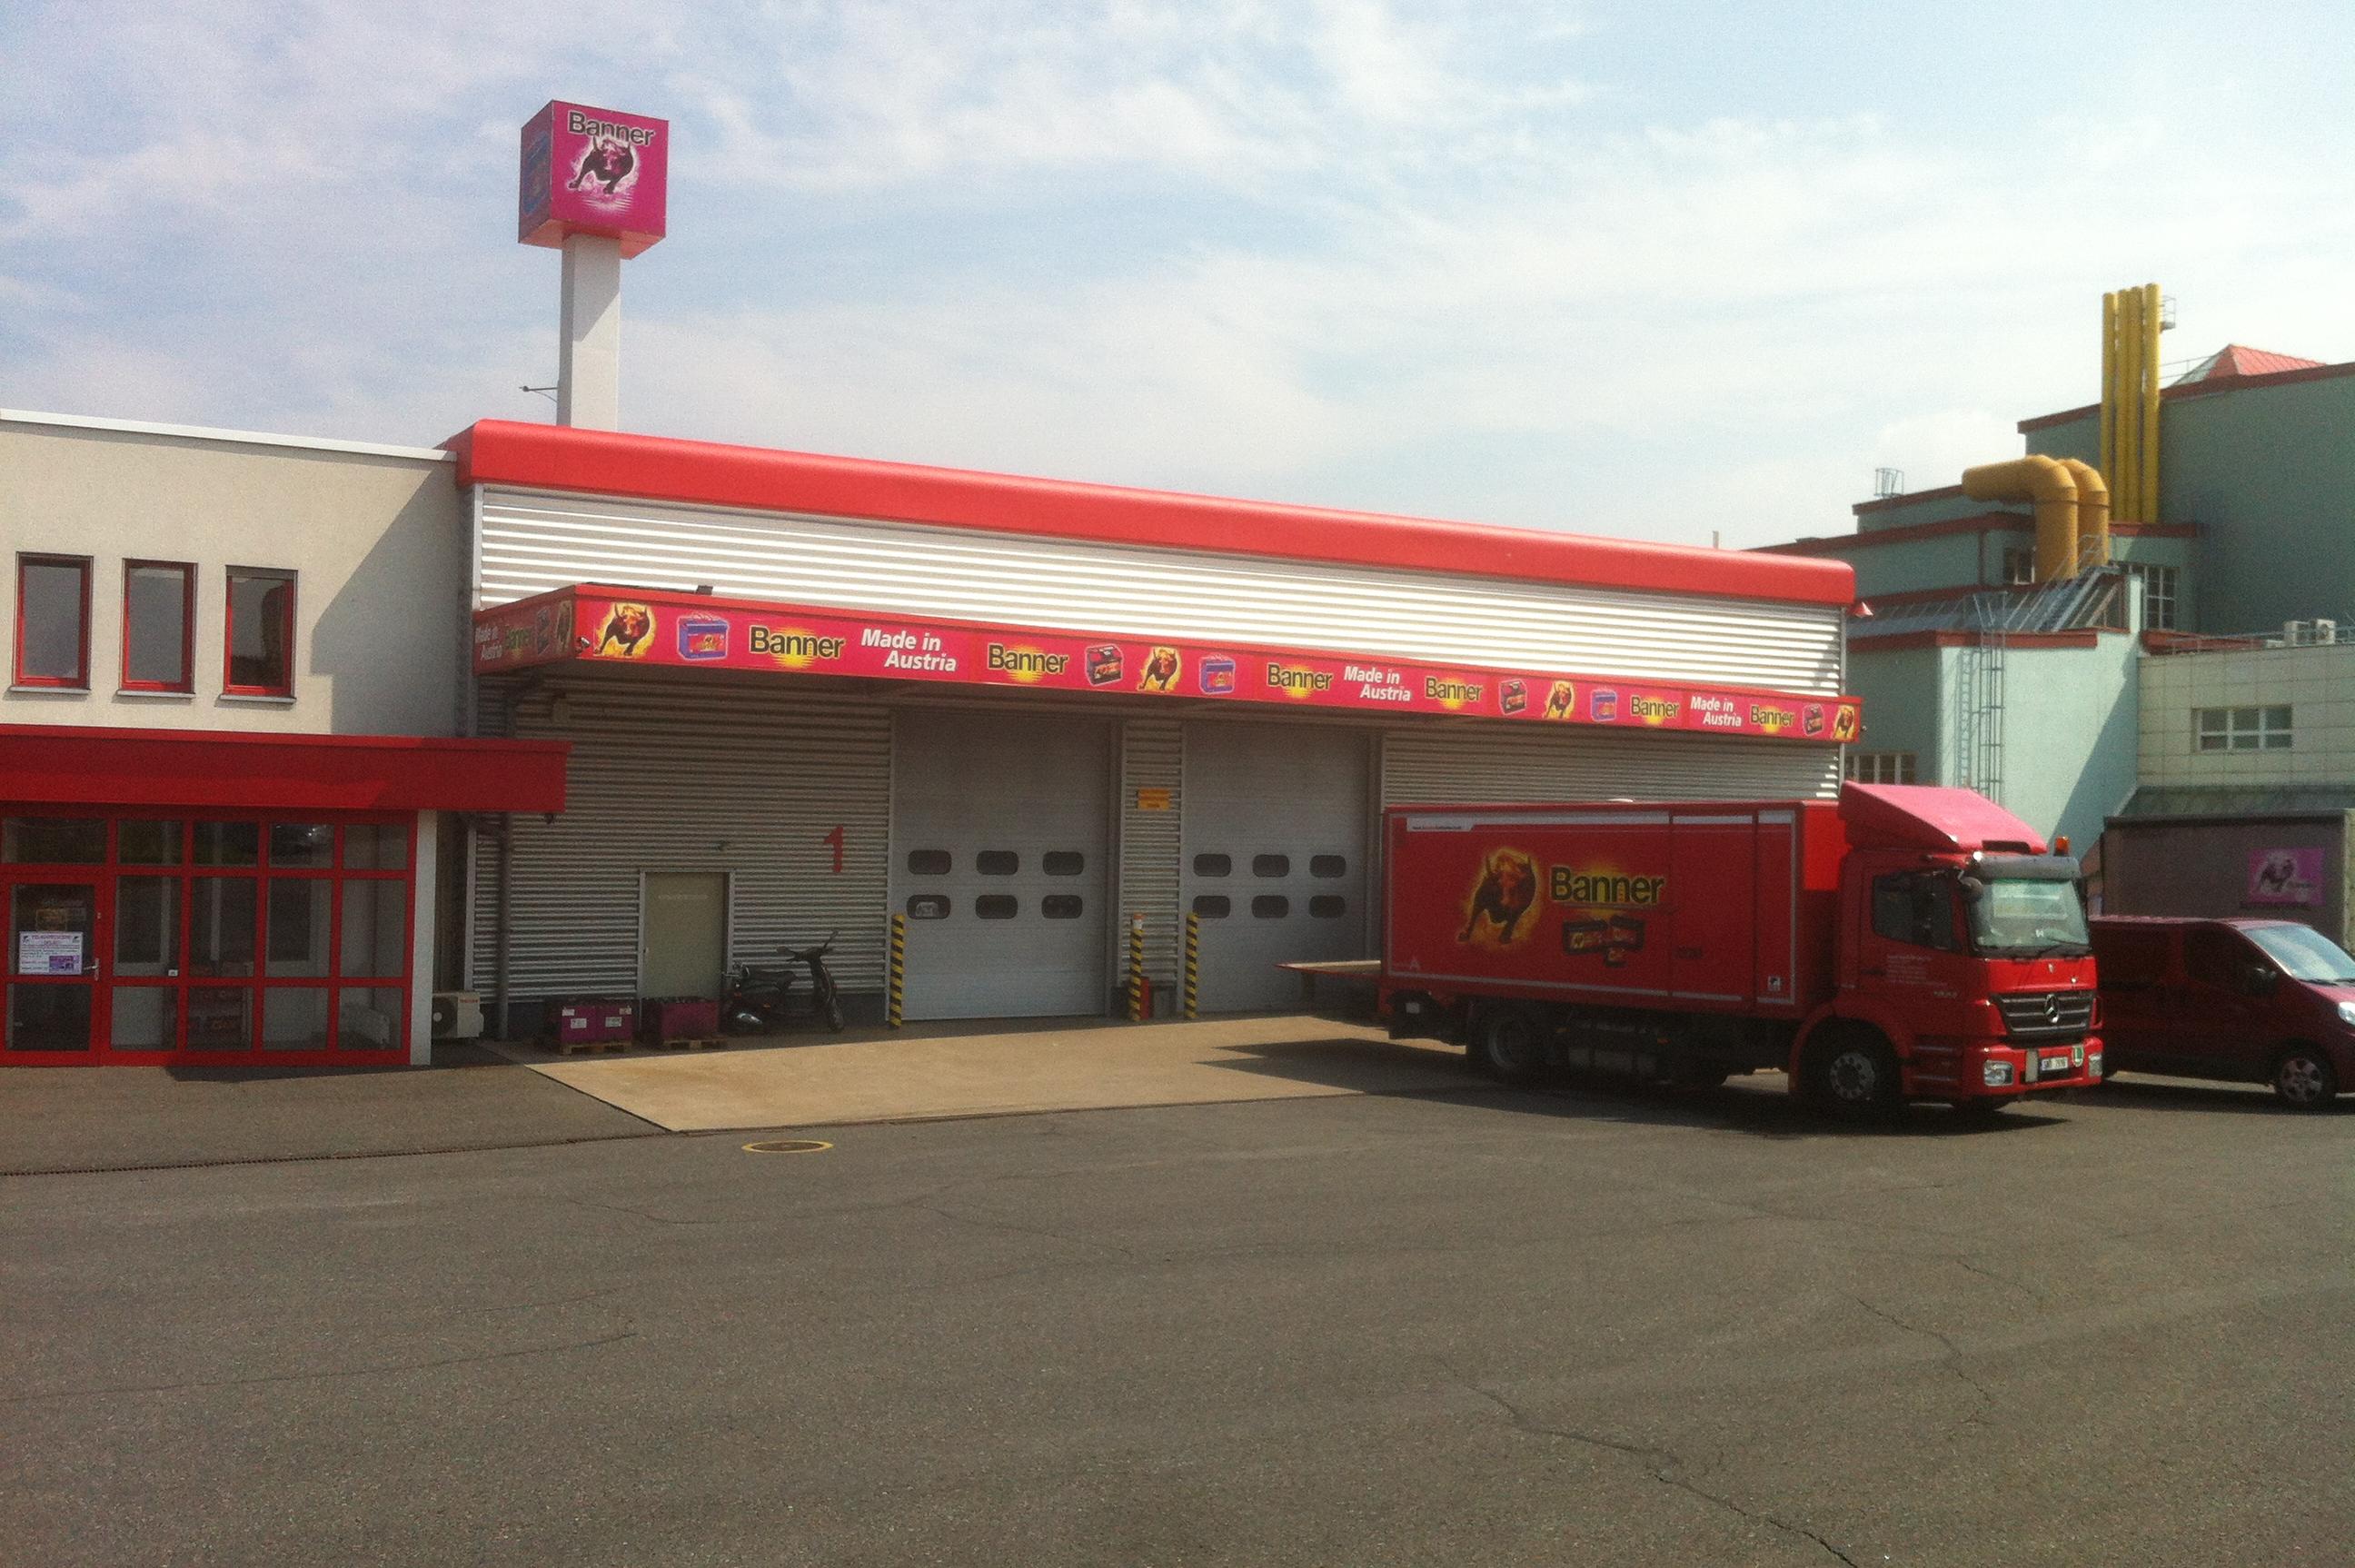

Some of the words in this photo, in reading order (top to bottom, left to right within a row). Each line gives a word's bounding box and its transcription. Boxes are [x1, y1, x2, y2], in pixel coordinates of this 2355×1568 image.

[567, 111, 655, 145] Banner
[749, 625, 845, 659] Banner
[861, 628, 917, 650] Made
[922, 631, 941, 651] in
[884, 650, 957, 672] Austria
[988, 643, 1069, 675] Banner
[1267, 662, 1334, 691] Banner
[1344, 666, 1384, 684] Made
[1386, 668, 1400, 685] in
[1359, 684, 1411, 702] Austria
[1425, 676, 1484, 702] Banner
[1631, 695, 1680, 719] Banner
[1690, 695, 1720, 712] Made
[1723, 697, 1734, 713] in
[1750, 704, 1795, 728] Banner
[1703, 711, 1743, 728] Austria
[823, 825, 844, 873] 1
[1549, 866, 1665, 906] Banner
